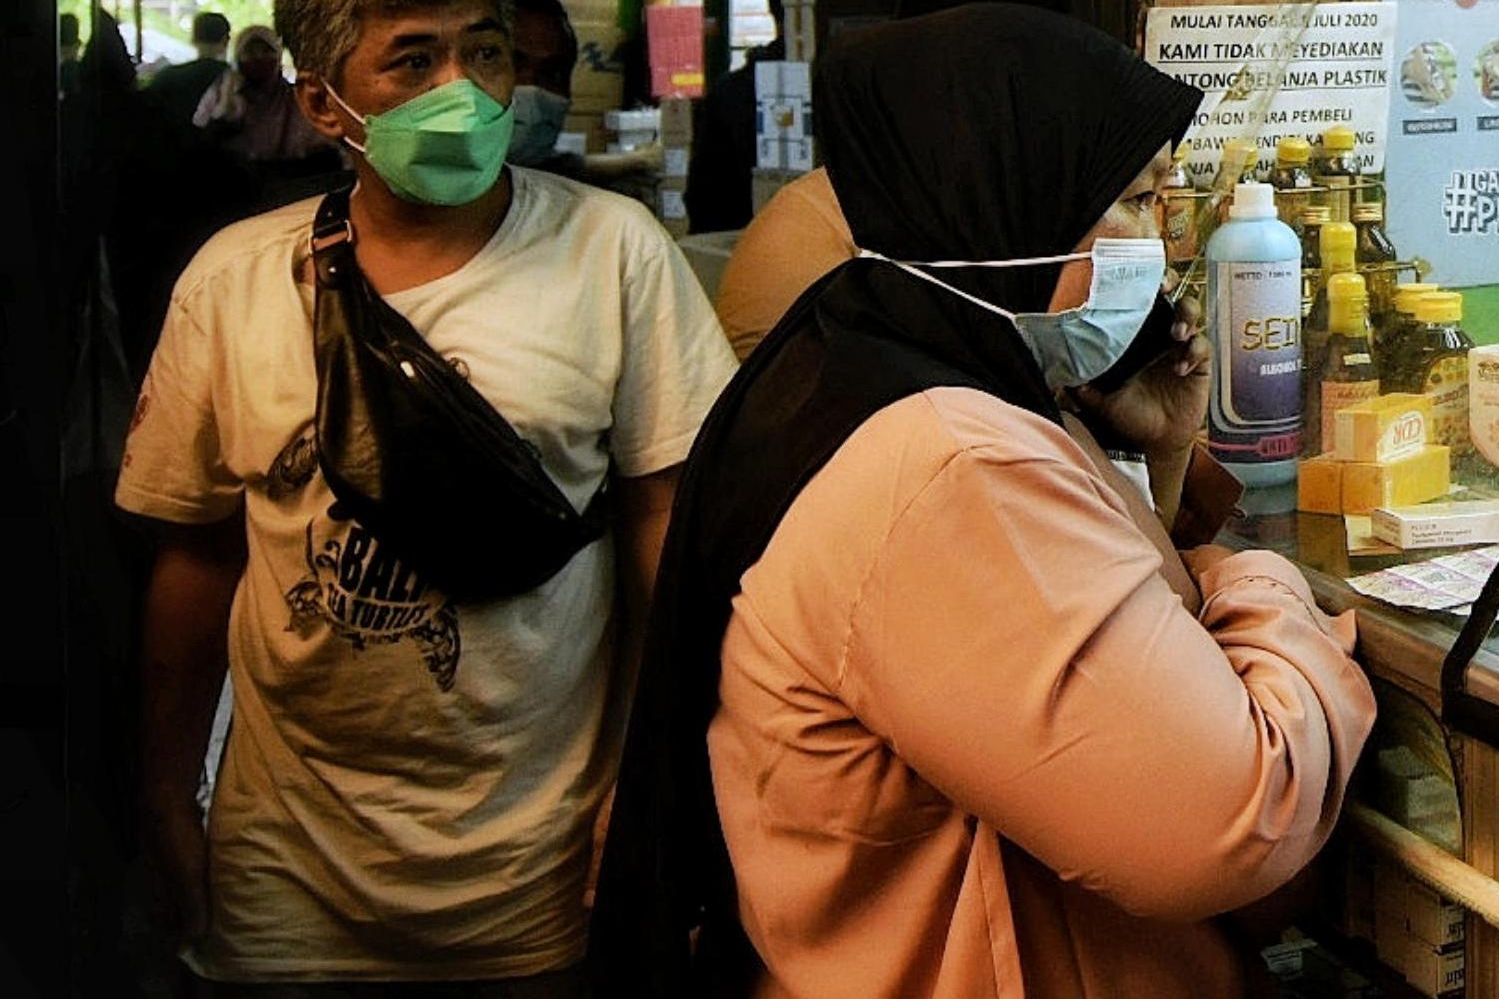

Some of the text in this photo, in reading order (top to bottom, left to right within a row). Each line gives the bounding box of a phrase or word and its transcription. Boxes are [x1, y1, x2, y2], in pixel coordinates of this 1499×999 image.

[1171, 14, 1222, 29] MULAI
[1312, 12, 1341, 28] JULI
[1345, 12, 1378, 27] 2020
[1159, 43, 1208, 60] KAMI
[1213, 42, 1266, 60] TIDAK
[1323, 69, 1388, 87] PLASTIK
[1291, 108, 1353, 123] PEMBELI
